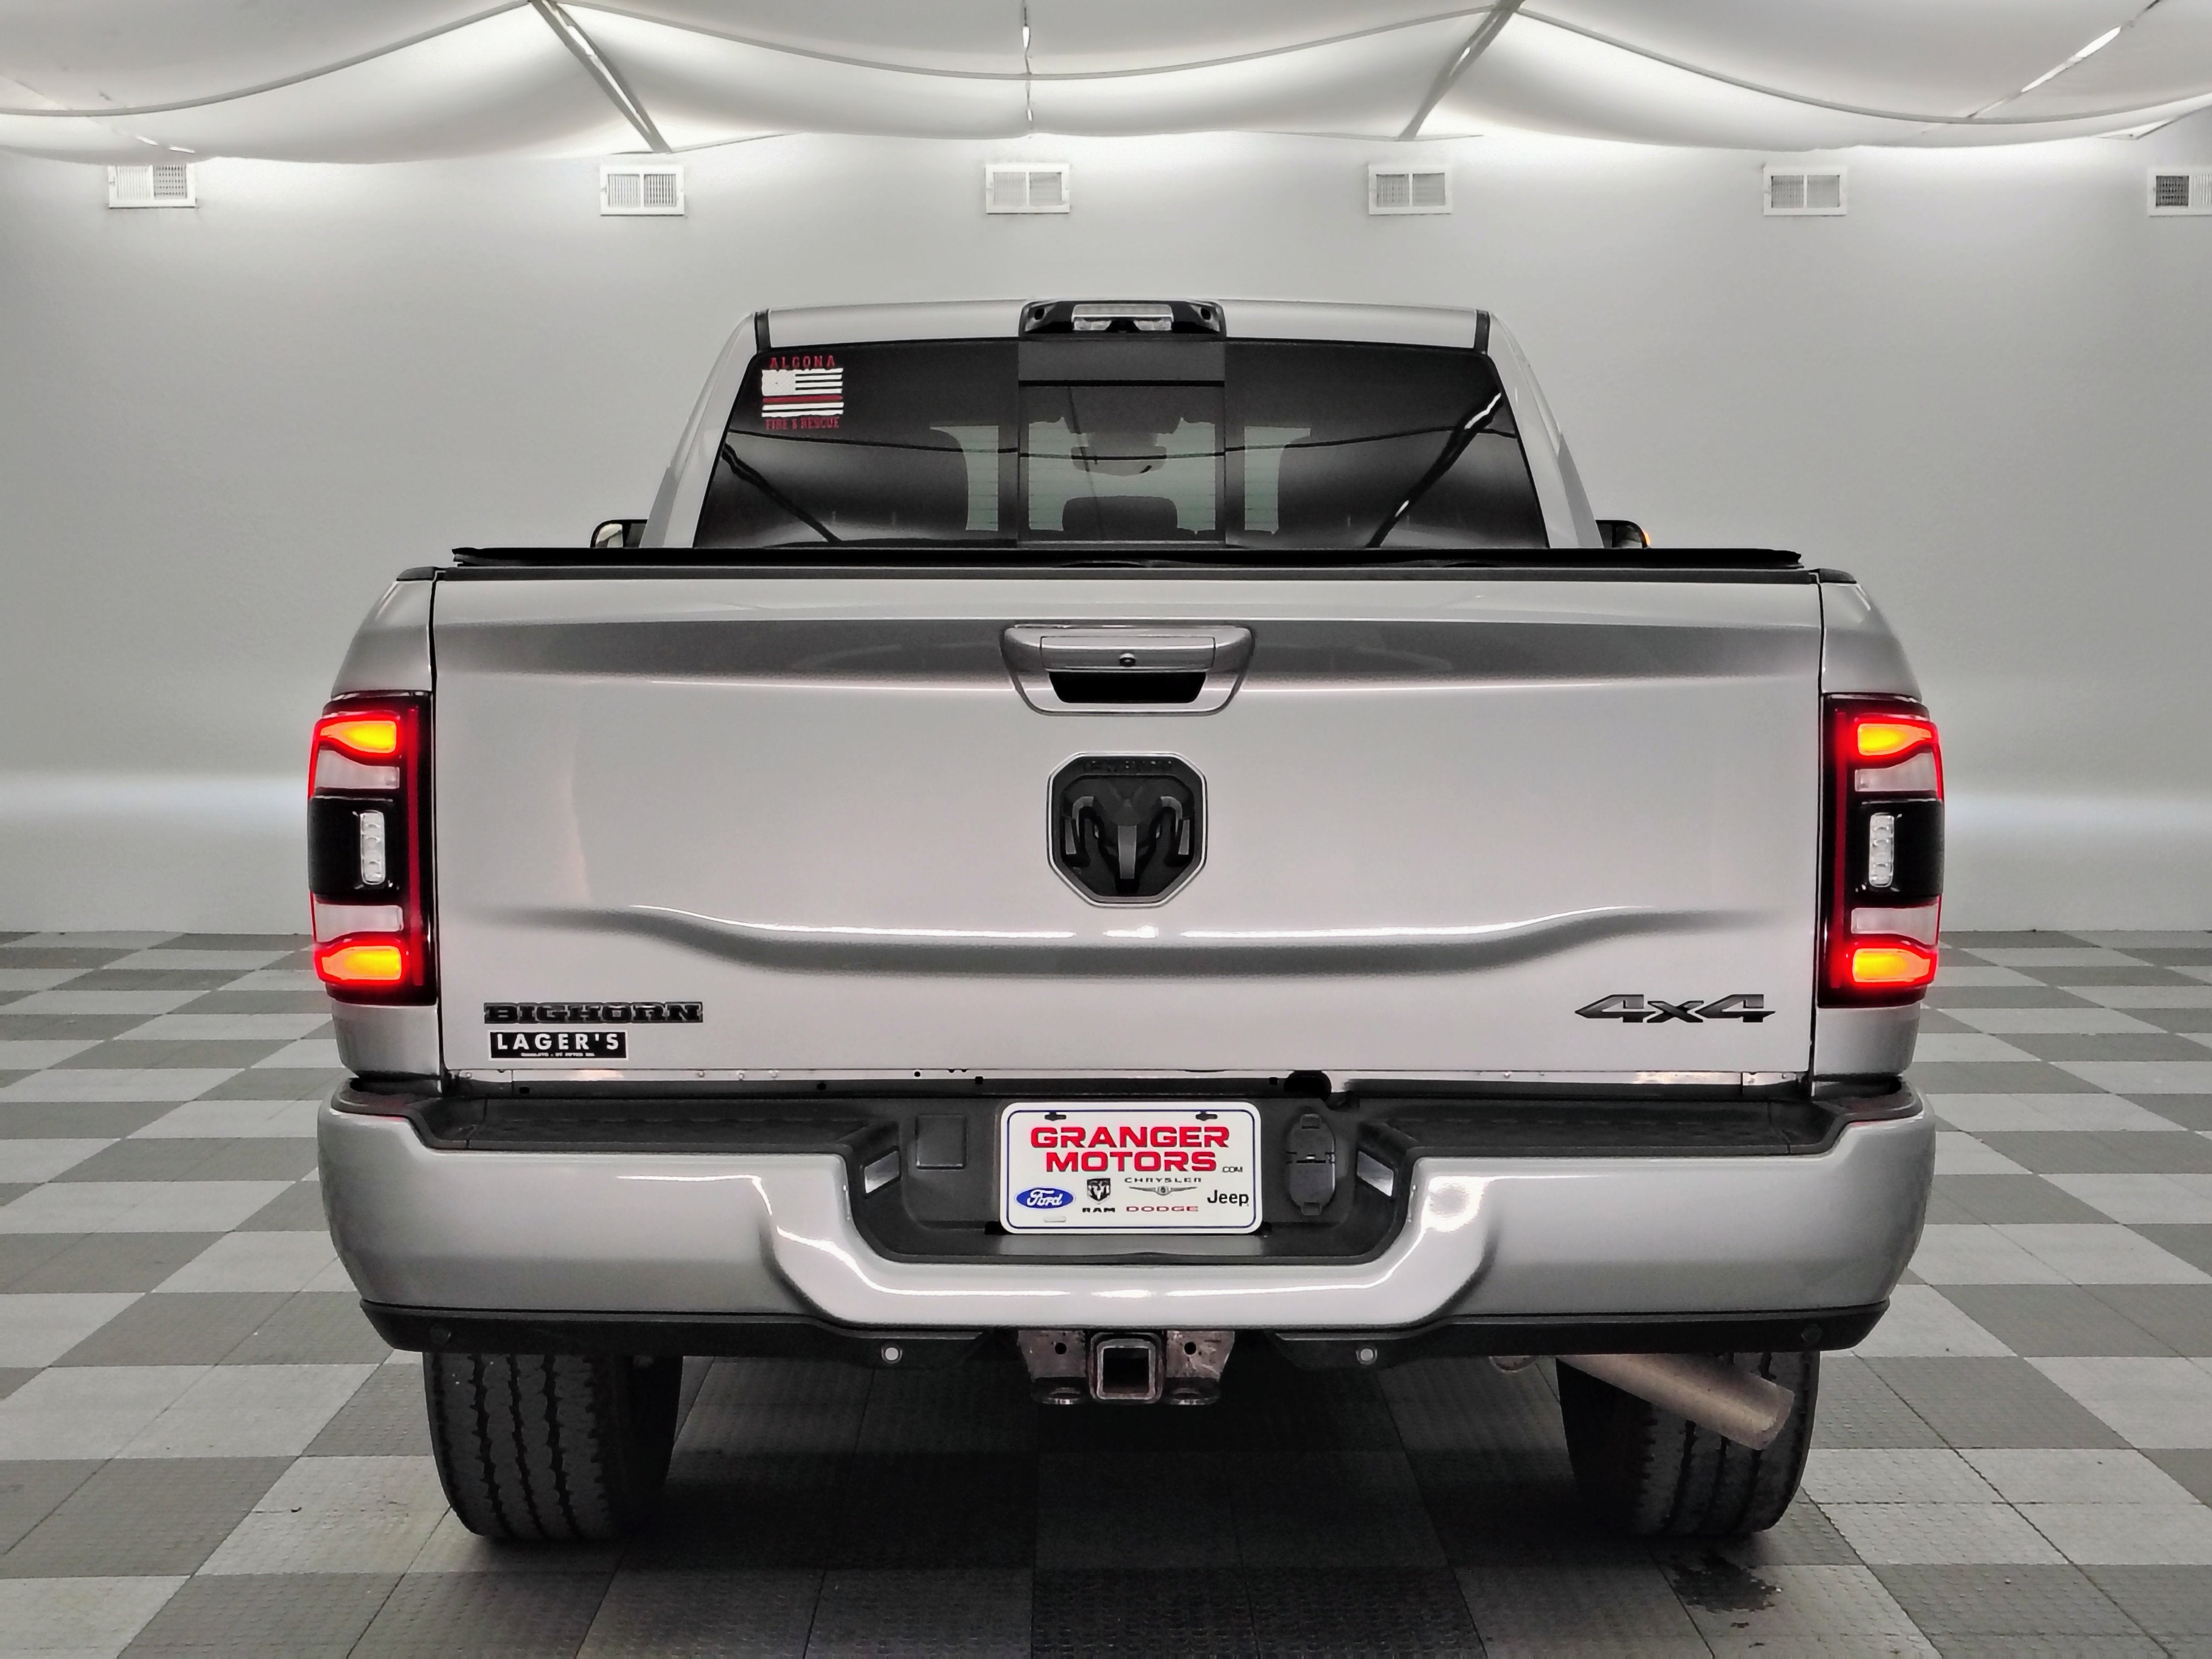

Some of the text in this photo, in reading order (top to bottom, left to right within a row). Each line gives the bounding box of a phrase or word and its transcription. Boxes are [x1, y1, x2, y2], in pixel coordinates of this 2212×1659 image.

[770, 355, 835, 368] ALGONA
[801, 416, 840, 429] RESCUE
[484, 1002, 703, 1024] BIGHORN
[497, 1034, 619, 1050] LAGER'S
[1031, 1127, 1230, 1148] GRANGER
[1046, 1151, 1217, 1172] MOTORS
[1027, 1189, 1063, 1207] Ford
[1207, 1190, 1249, 1207] Jeep
